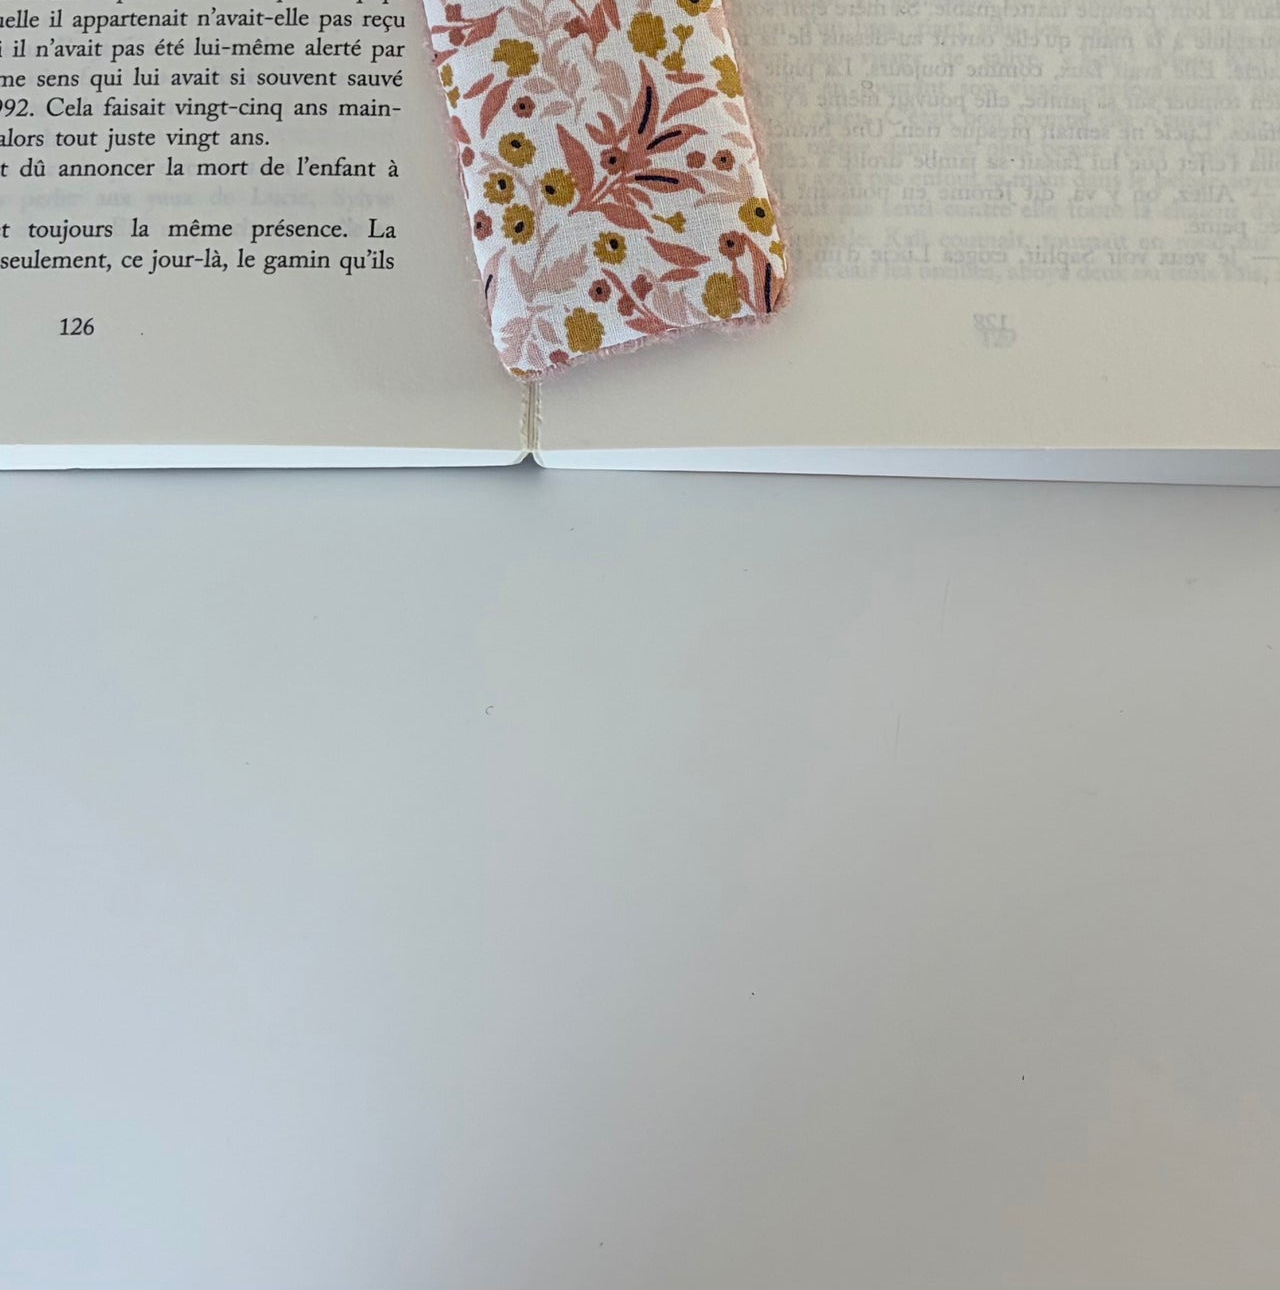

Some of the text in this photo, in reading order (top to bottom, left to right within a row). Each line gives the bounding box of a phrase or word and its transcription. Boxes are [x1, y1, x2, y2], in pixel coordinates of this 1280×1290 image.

[36, 73, 80, 88] sens
[89, 68, 123, 94] qui
[132, 66, 160, 87] lui
[170, 67, 221, 86] avait
[229, 67, 246, 86] si
[256, 71, 338, 87] souvent
[346, 69, 403, 88] sauvé
[55, 131, 99, 147] tout
[104, 127, 156, 153] juste
[165, 127, 221, 153] vingt
[229, 132, 270, 146] ans.
[27, 218, 114, 245] toujours
[130, 216, 150, 238] la
[167, 218, 233, 238] même
[249, 218, 348, 244] présence.
[367, 217, 397, 239] La
[0, 248, 112, 273] seulement,
[120, 254, 144, 269] ce
[147, 247, 229, 275] jour-là,
[236, 247, 256, 269] le
[262, 249, 331, 275] gamin
[339, 248, 395, 276] qu'ils
[59, 317, 95, 336] 126
